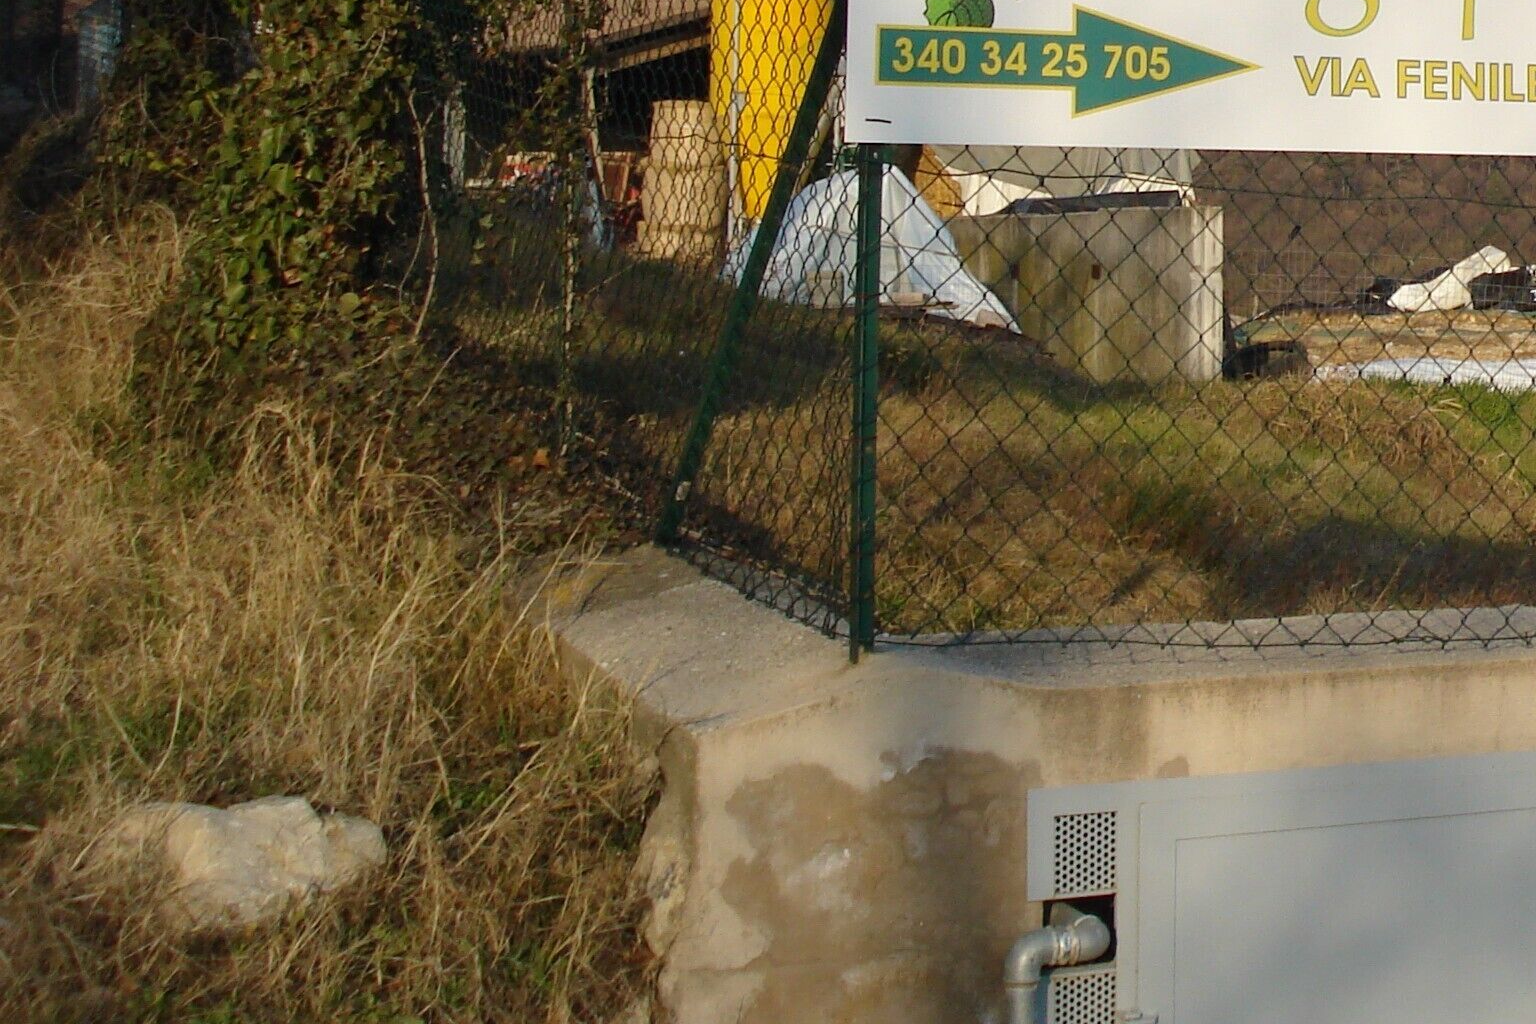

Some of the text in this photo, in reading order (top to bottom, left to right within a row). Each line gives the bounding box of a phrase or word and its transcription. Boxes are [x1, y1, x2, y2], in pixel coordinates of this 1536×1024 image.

[892, 39, 1171, 81] 340 34 25 705
[1294, 56, 1381, 98] VIA
